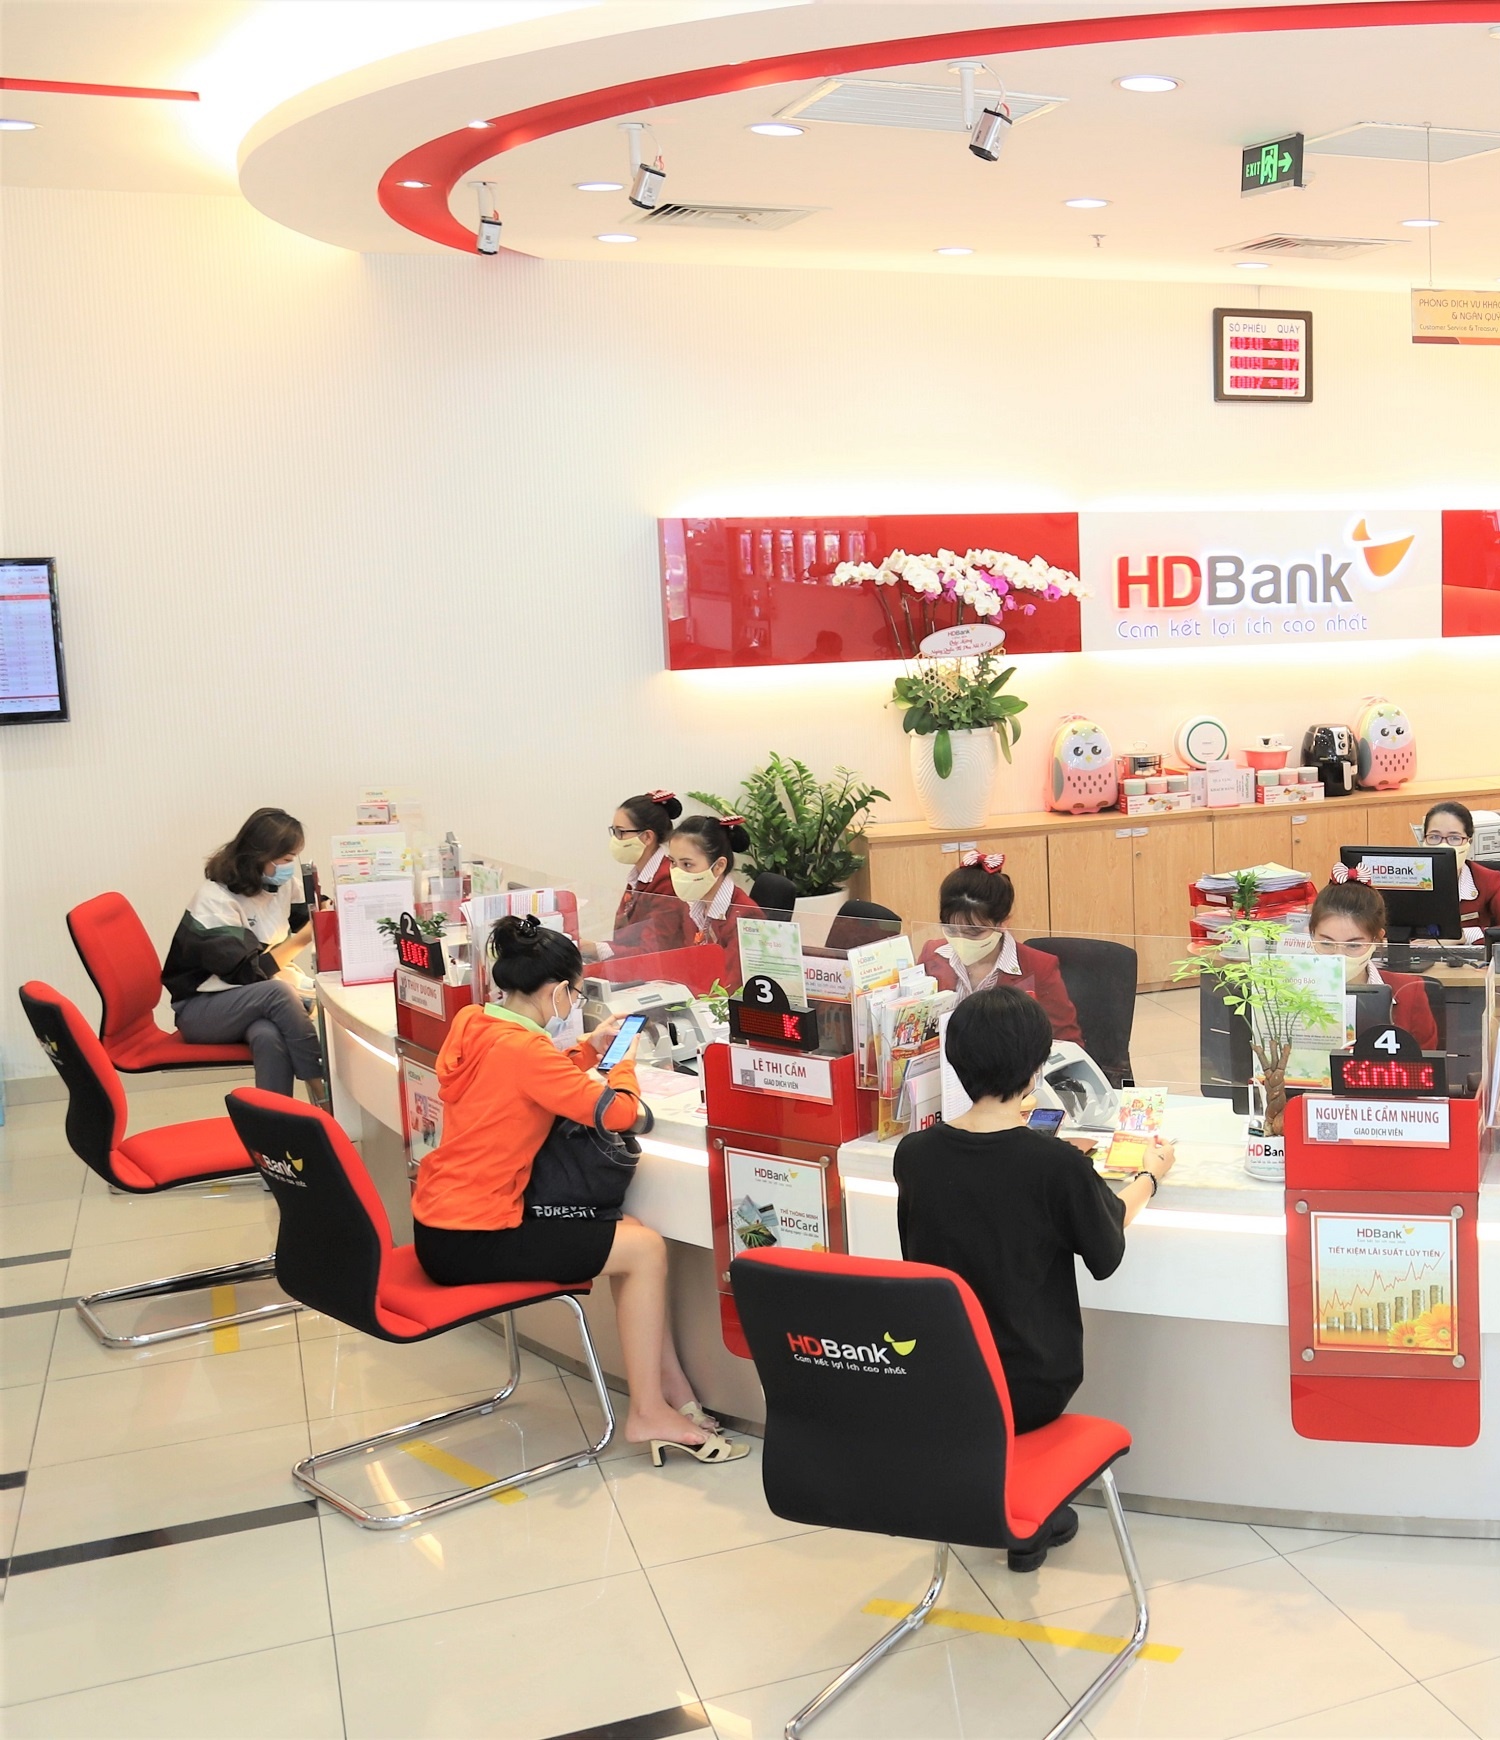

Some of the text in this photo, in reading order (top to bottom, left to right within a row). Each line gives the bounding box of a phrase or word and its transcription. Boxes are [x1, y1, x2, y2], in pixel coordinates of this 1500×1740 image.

[1245, 161, 1260, 177] EXIT
[1452, 312, 1458, 320] &
[1419, 323, 1446, 331] Customer
[1475, 325, 1498, 333] Treasury
[1117, 553, 1354, 608] HDBank
[1118, 613, 1368, 638] Cam kết lợi ích cao nhất
[1372, 865, 1414, 875] HDBank
[403, 914, 415, 935] 2
[755, 979, 773, 1003] 3
[782, 1013, 802, 1040] K
[1374, 1030, 1400, 1054] 4
[753, 1058, 764, 1071] LÊ
[765, 1061, 782, 1077] THỊ
[921, 1111, 942, 1130] HDB
[1316, 1104, 1358, 1121] NGUYỄN
[1361, 1106, 1373, 1121] LÊ
[1401, 1110, 1439, 1124] NHUNG
[1354, 1127, 1403, 1138] GIAO DỊCH VIÊN
[1248, 1144, 1284, 1157] HDBan
[754, 1167, 789, 1183] HDBank
[780, 1216, 819, 1233] HDCard
[1357, 1228, 1402, 1239] HDBank
[1329, 1246, 1345, 1254] TIẾT
[1347, 1246, 1366, 1257] KIỆM
[1383, 1248, 1403, 1257] SUẤT
[1423, 1249, 1440, 1258] TIẾN
[786, 1332, 890, 1364] HDBank
[794, 1353, 907, 1375] Cam kết lợi ích cao nhất
